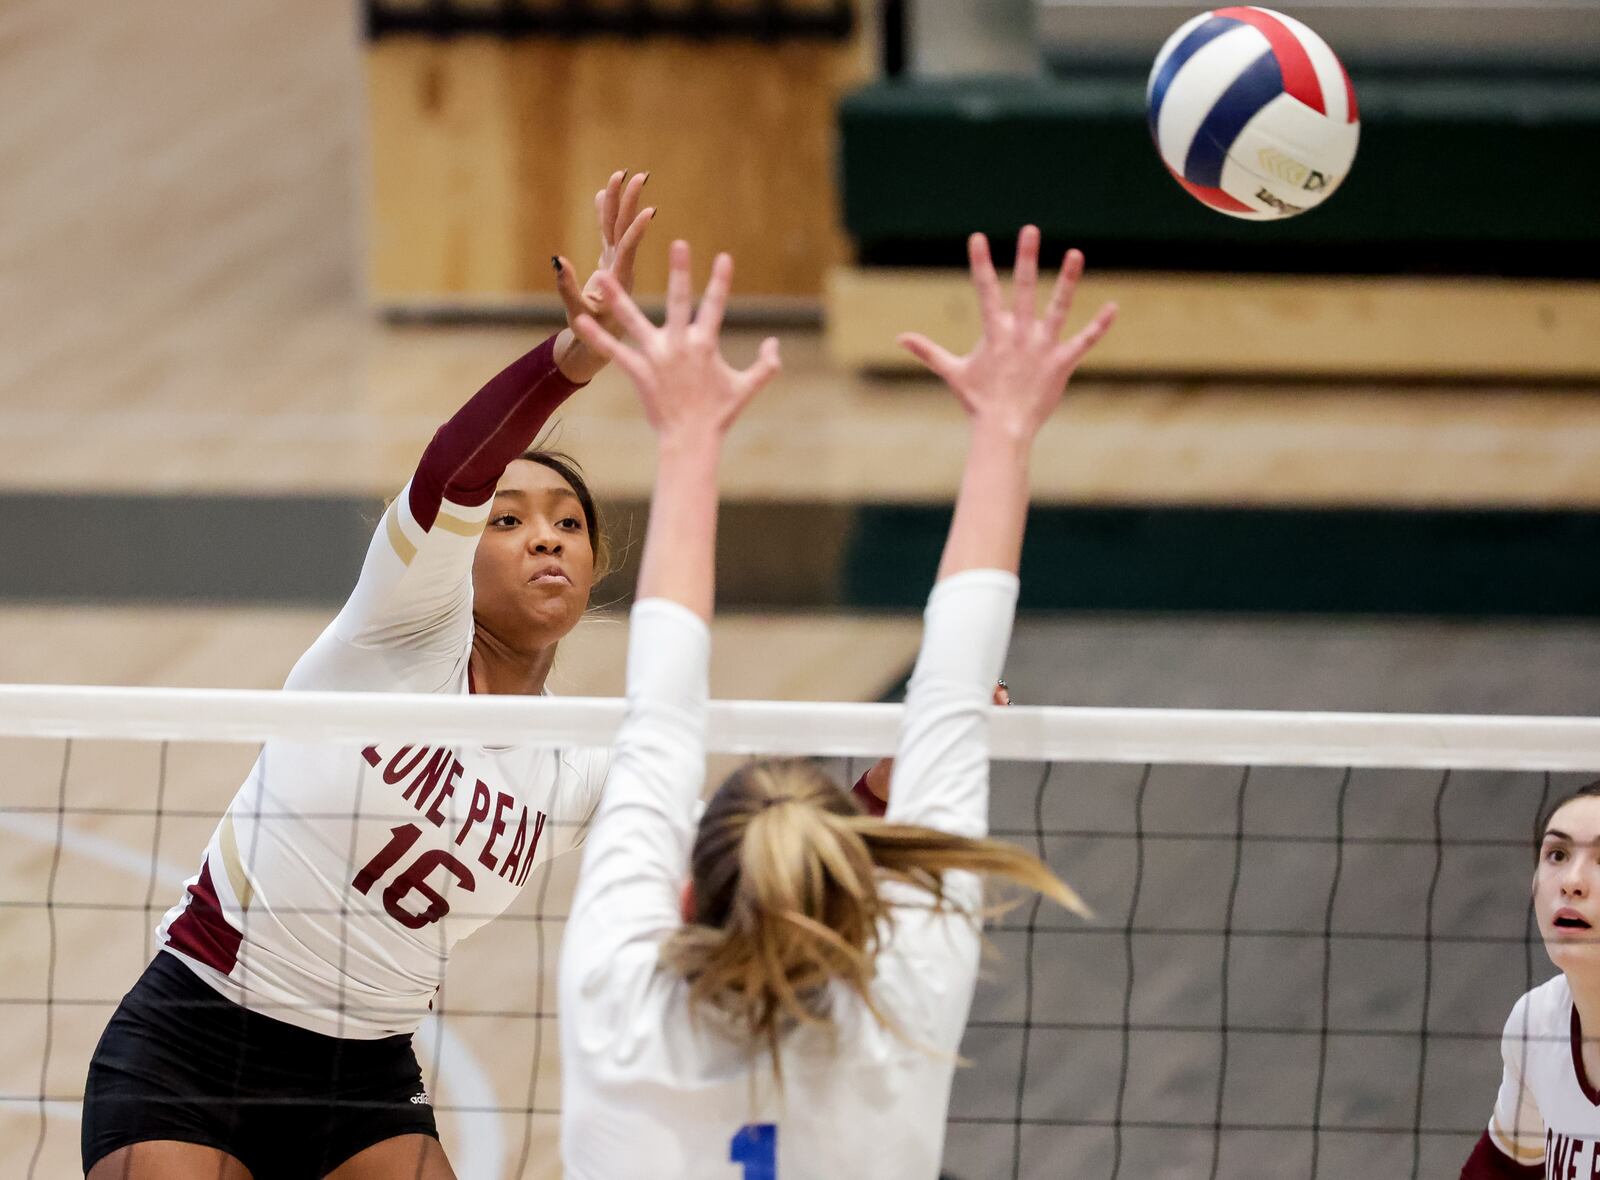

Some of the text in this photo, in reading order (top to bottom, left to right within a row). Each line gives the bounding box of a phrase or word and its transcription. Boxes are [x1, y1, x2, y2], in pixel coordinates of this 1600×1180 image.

[351, 822, 476, 929] 16
[455, 778, 547, 887] PEAK
[1543, 1126, 1584, 1180] ONE
